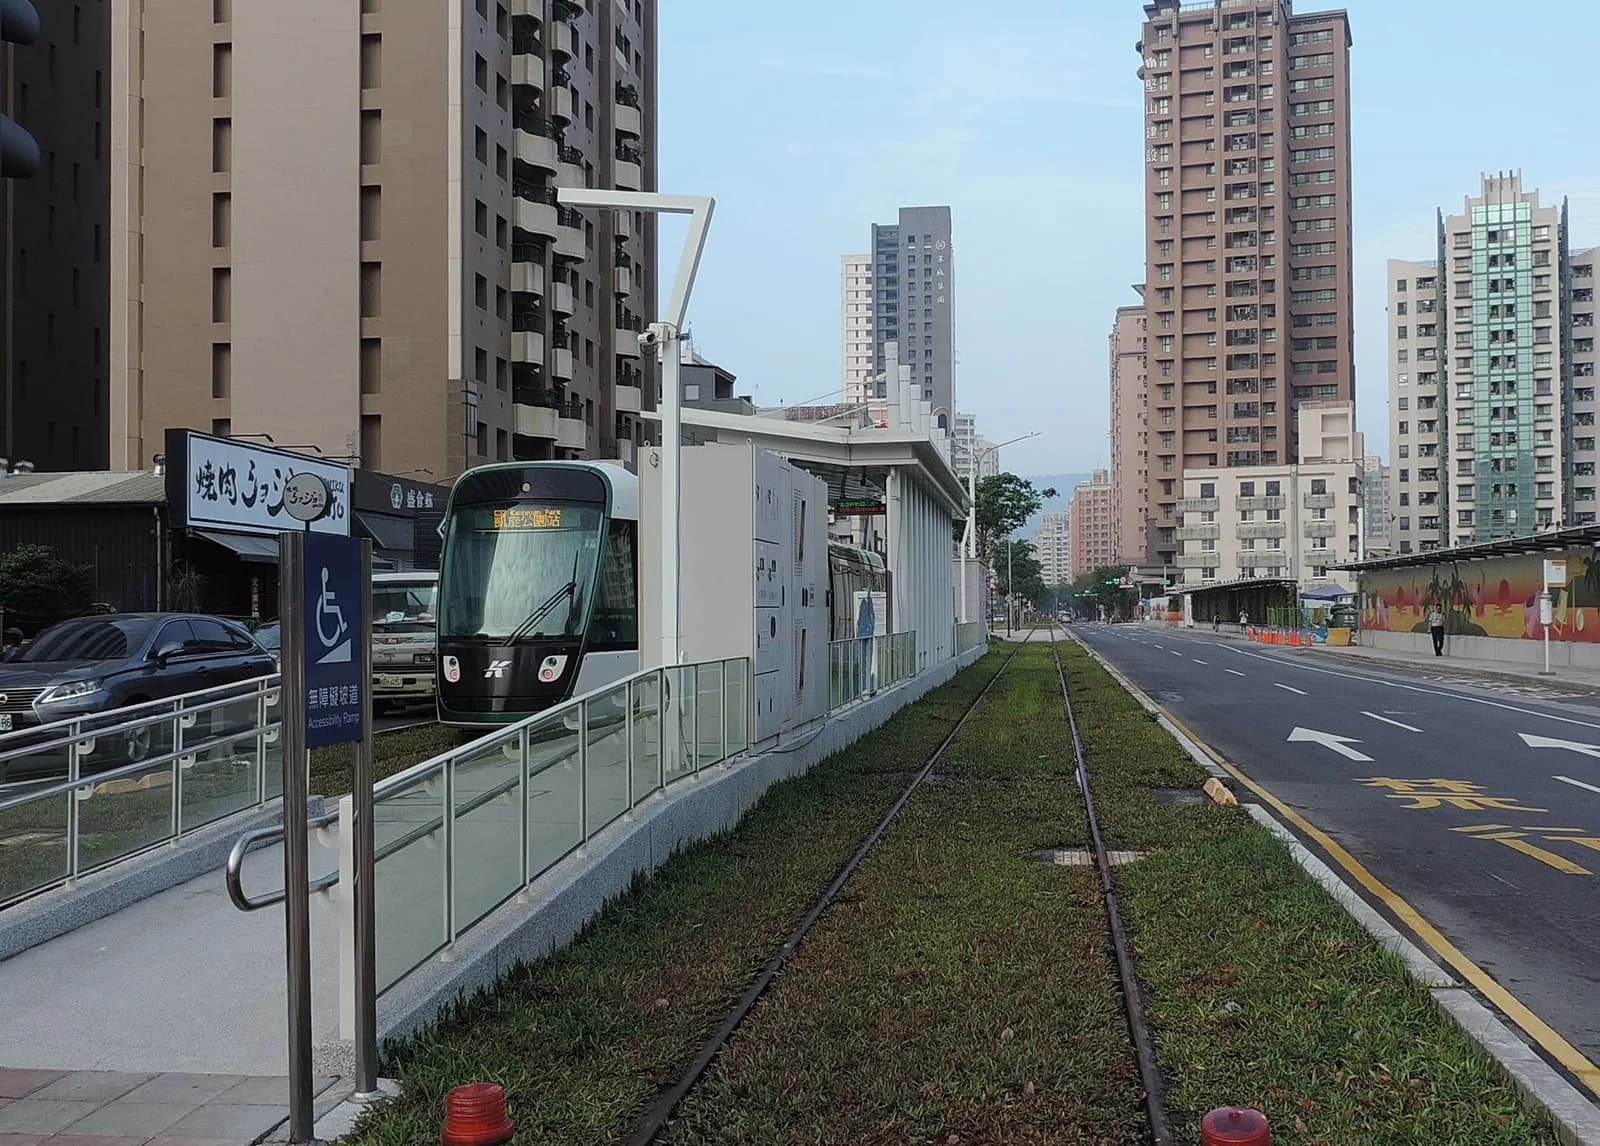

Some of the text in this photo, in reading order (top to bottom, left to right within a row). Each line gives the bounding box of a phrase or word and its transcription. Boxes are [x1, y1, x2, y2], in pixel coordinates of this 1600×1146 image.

[309, 685, 358, 709] 無障礙坡道
[308, 712, 359, 728] Accessibility Ramp
